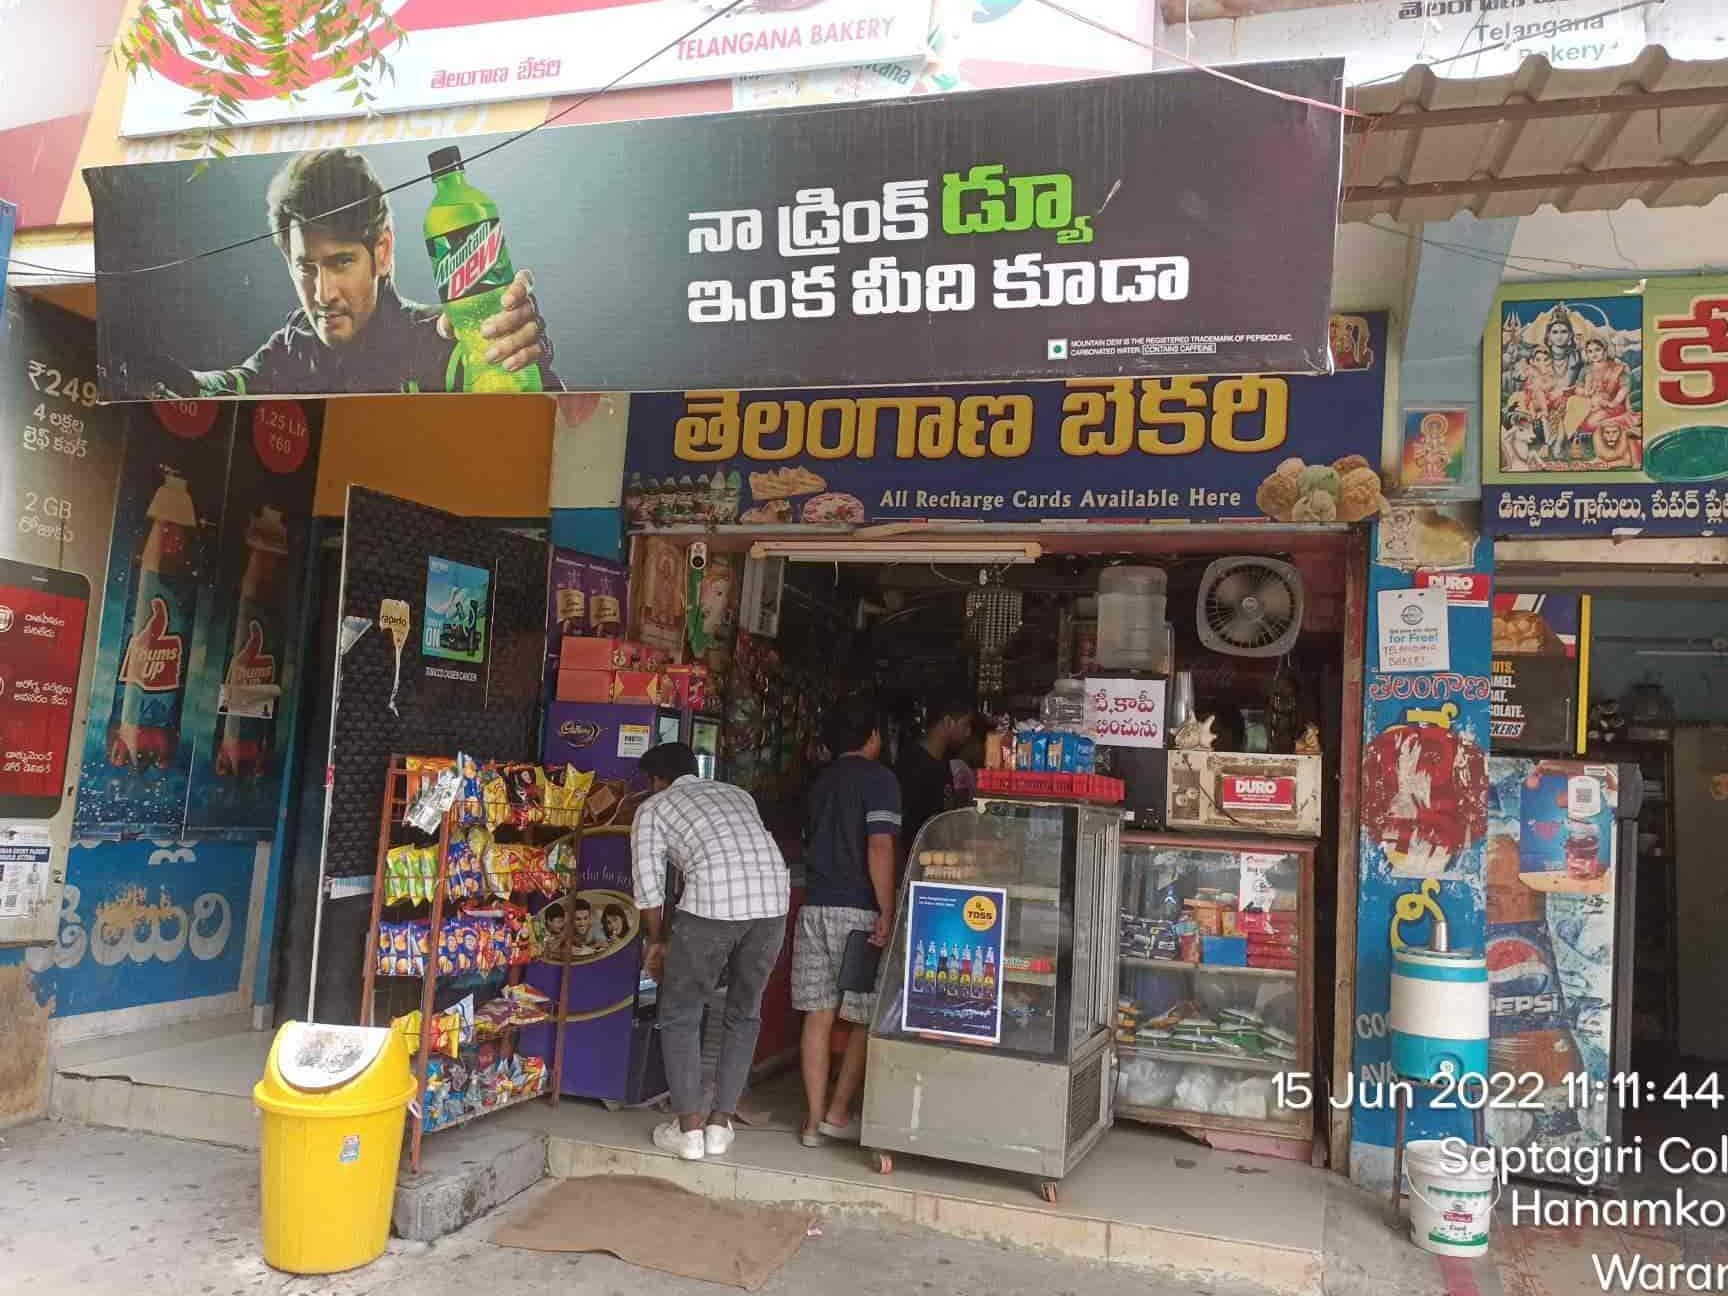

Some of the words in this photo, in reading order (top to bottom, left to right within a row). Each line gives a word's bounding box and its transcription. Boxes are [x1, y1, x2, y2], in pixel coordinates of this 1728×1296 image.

[676, 25, 801, 60] TELANGANA
[810, 17, 895, 45] BAKERY
[1475, 15, 1605, 41] Telangana
[688, 207, 763, 254] నా
[777, 178, 929, 258] డ్రింక్
[434, 220, 491, 289] Mountain
[688, 264, 837, 323] ఇంక
[851, 256, 976, 315] మీది
[993, 253, 1190, 310] కూడా
[1071, 338, 1104, 348] MOUNTAIN
[1131, 336, 1144, 346] THE
[1145, 335, 1189, 345] REGISTERED
[1191, 335, 1233, 344] TRADEMARK
[1235, 334, 1244, 343] OF
[1071, 347, 1115, 357] CARBONATED
[1145, 344, 1178, 354] CONTAINS
[33, 403, 46, 422] 4
[675, 388, 1034, 460] తెలంగాణ
[25, 491, 37, 511] 2
[44, 497, 72, 520] GB
[880, 490, 907, 507] All
[916, 489, 1004, 510] Recharge
[1012, 490, 1072, 508] Cards
[1080, 488, 1178, 507] Available
[1188, 487, 1241, 506] Here
[1705, 488, 1728, 524] ప్లే
[1428, 575, 1474, 588] DURO
[1369, 673, 1490, 700] తెలంగాణ
[1235, 779, 1278, 794] DURO
